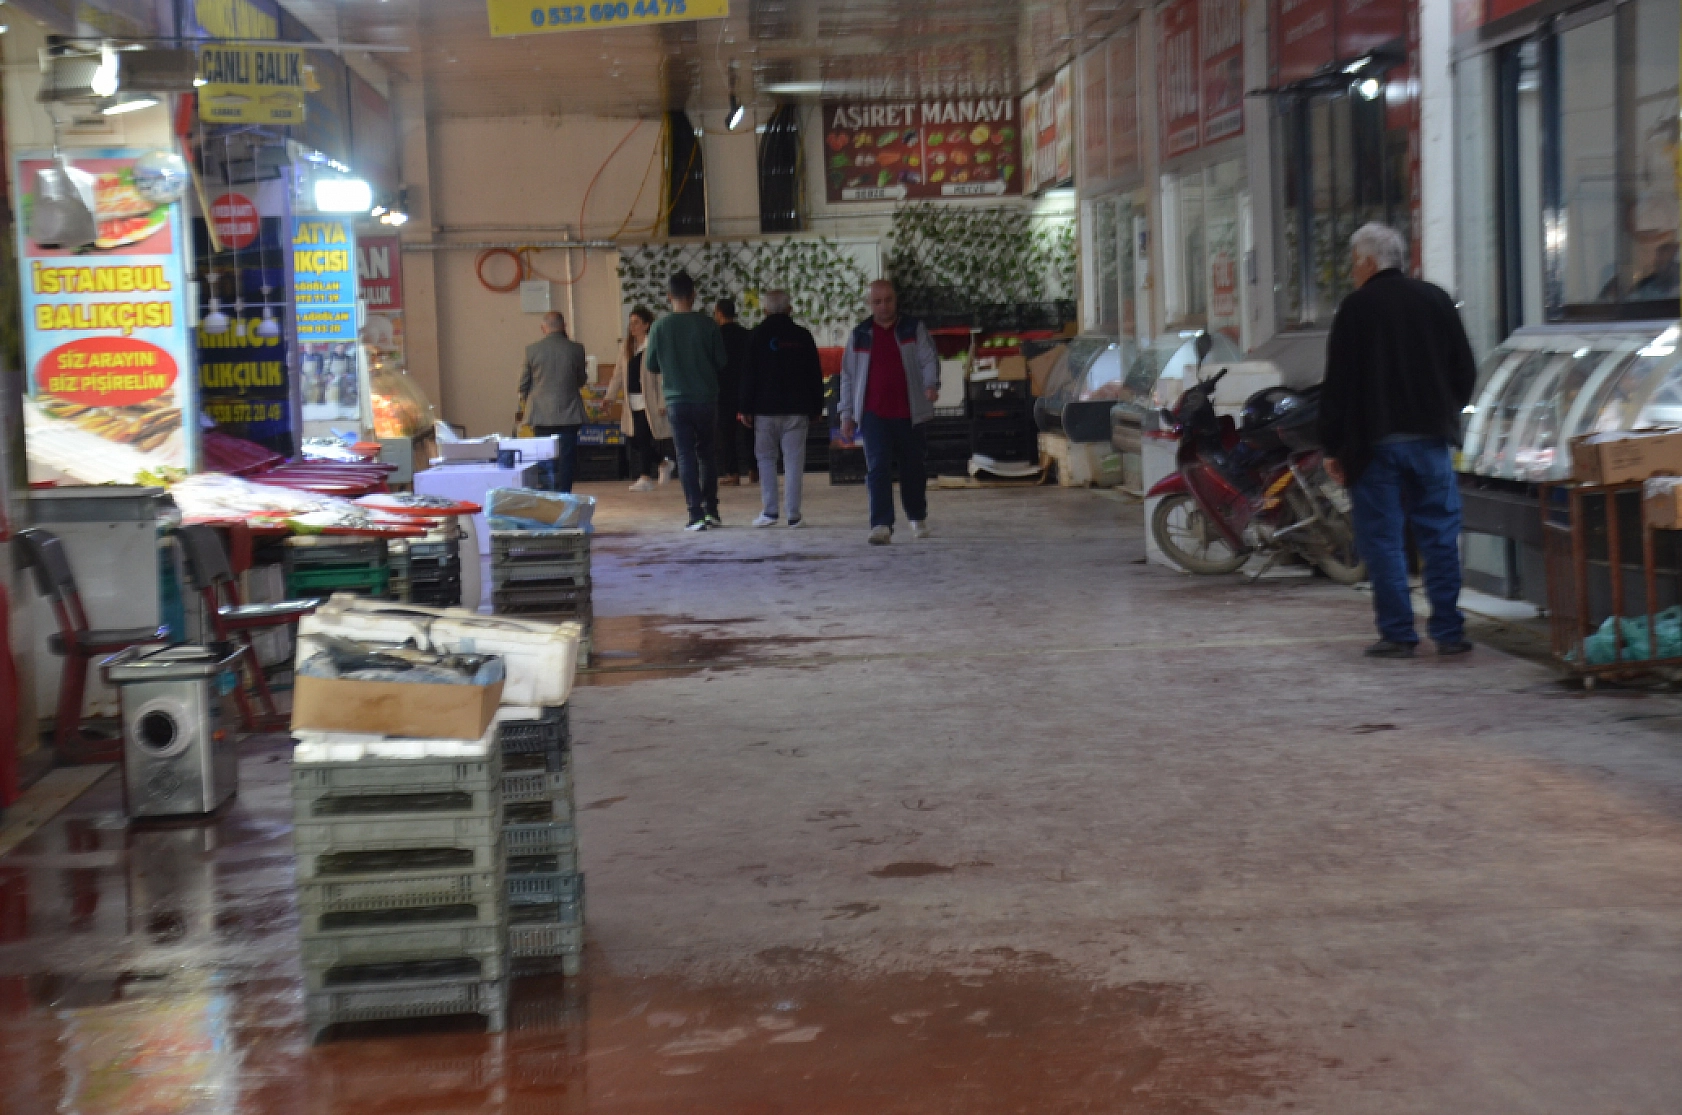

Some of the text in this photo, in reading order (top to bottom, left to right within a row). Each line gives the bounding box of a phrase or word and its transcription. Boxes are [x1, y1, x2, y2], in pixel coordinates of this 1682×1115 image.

[531, 8, 545, 26] 0
[549, 5, 586, 25] 532
[590, 2, 629, 21] 690
[633, 0, 660, 17] 44
[202, 49, 300, 86] CANLI BALIK
[32, 261, 172, 294] İSTANBUL
[35, 301, 172, 336] BALIKÇISI
[57, 349, 156, 369] SİZ ARAYIN
[49, 371, 167, 395] BİZ PİŞİRELİM
[199, 361, 282, 395] LIKÇILIK
